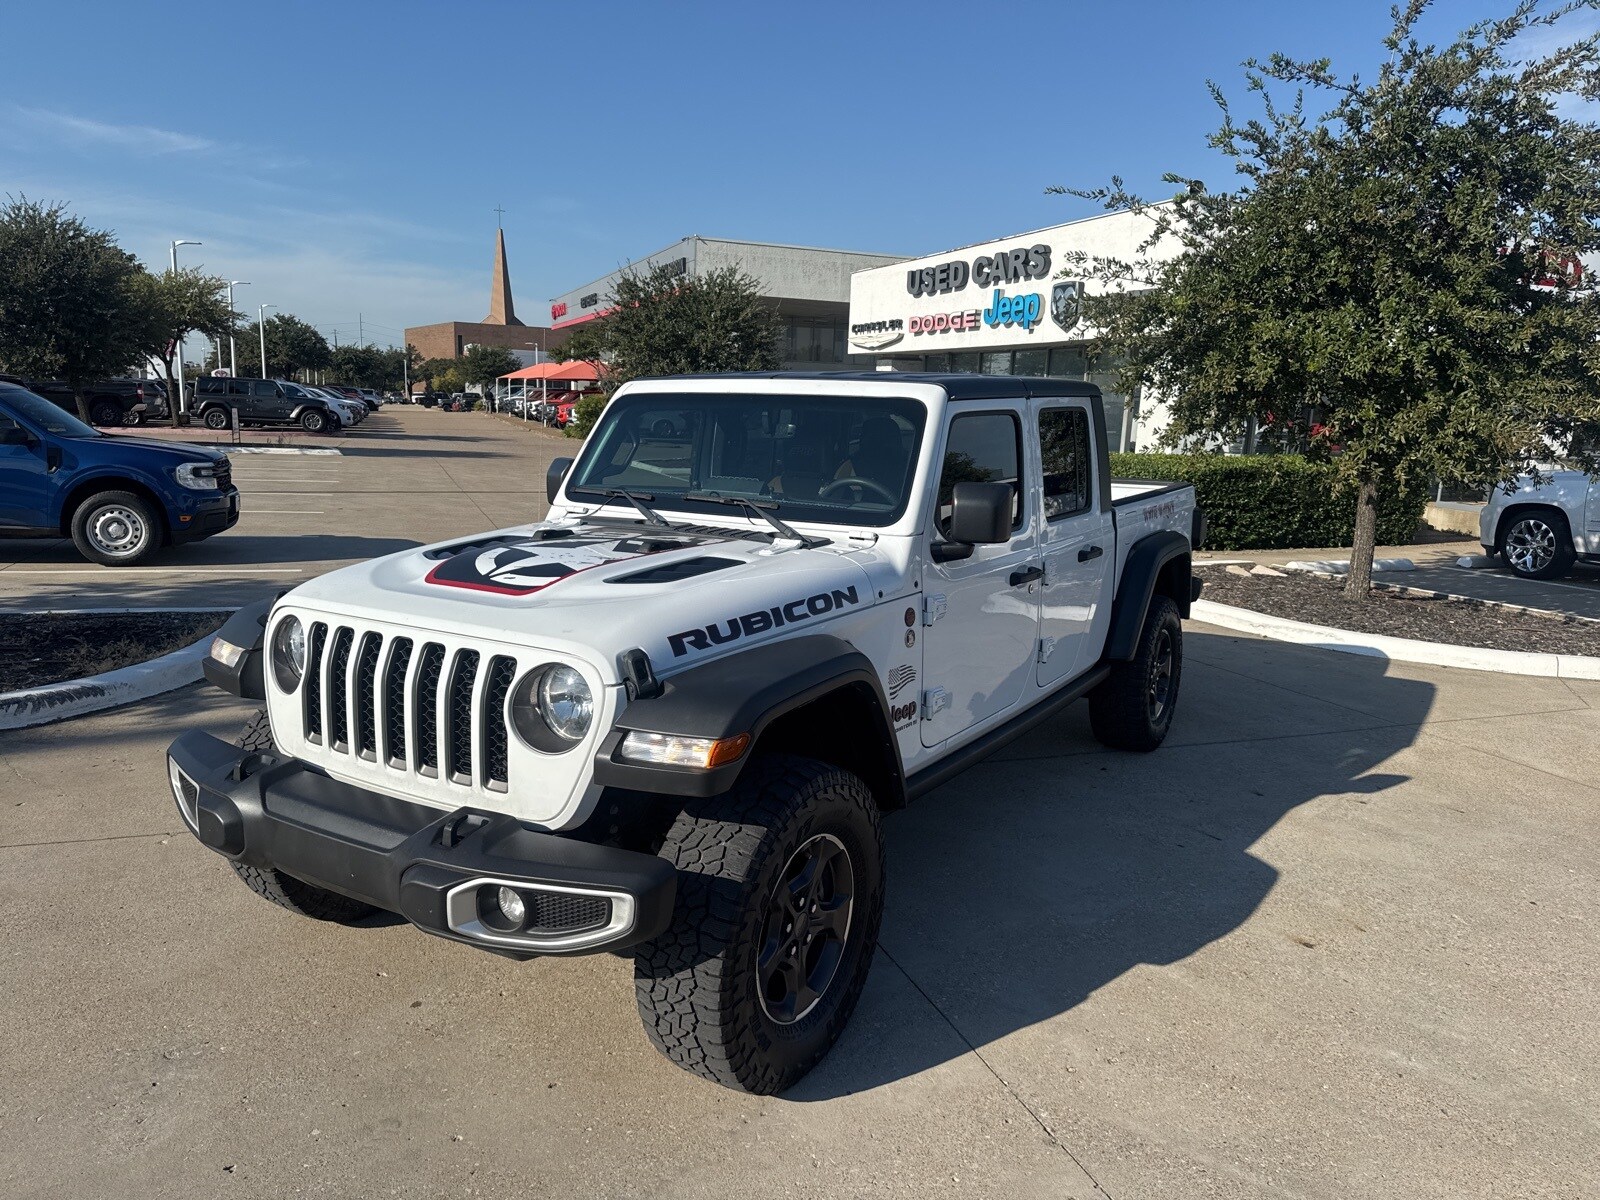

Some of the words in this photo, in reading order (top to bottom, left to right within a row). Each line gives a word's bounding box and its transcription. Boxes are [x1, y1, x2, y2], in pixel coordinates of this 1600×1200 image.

[907, 261, 968, 297] USED
[972, 244, 1051, 288] CARS
[909, 309, 979, 334] DODGE
[983, 289, 1041, 330] Jeep
[667, 585, 859, 657] RUBICON
